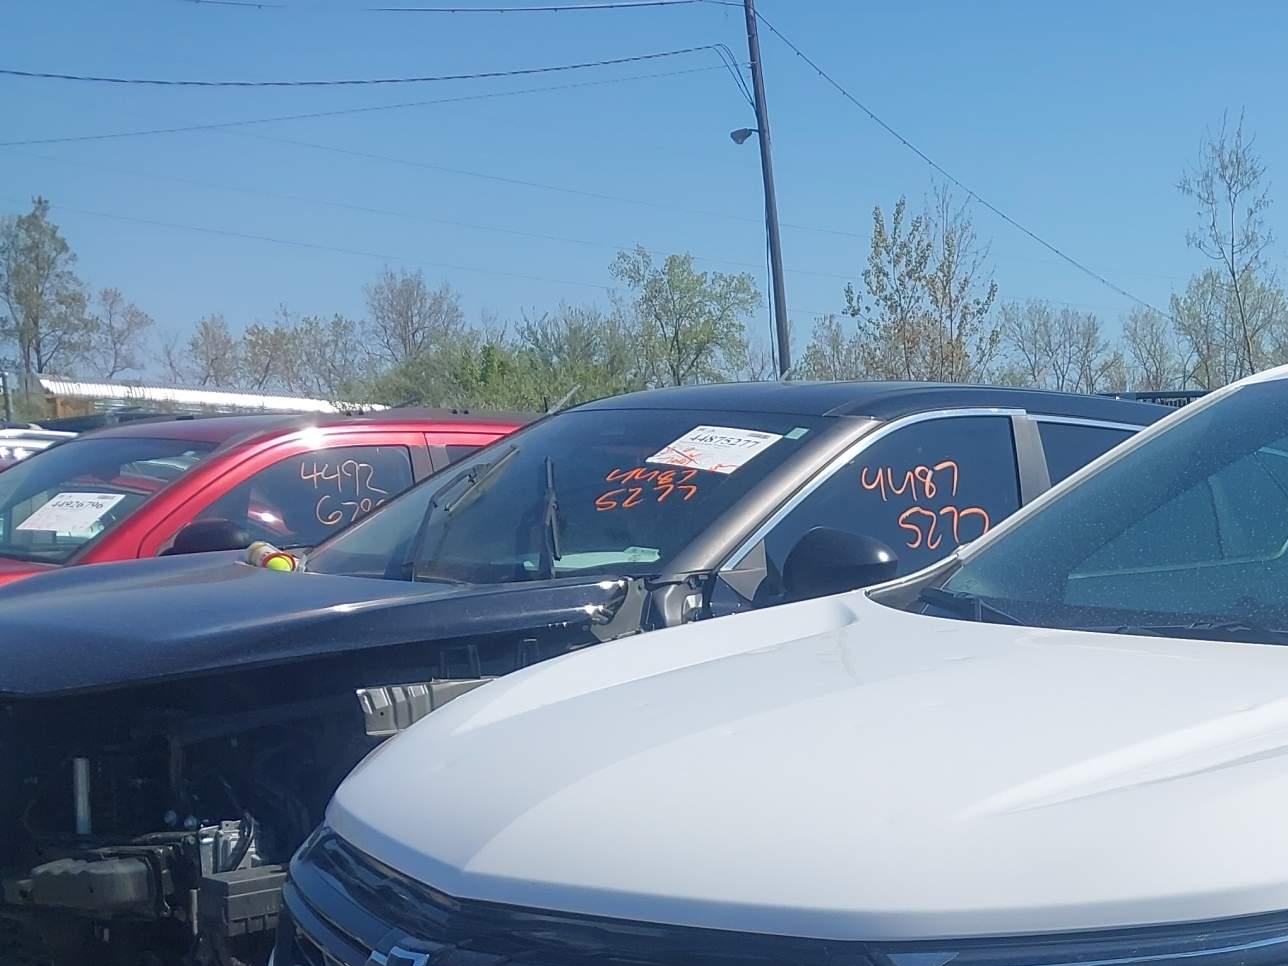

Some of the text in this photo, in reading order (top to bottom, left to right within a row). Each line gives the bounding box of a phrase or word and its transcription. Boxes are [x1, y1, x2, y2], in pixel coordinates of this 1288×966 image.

[690, 433, 760, 448] 44875277
[301, 460, 388, 496] 4492
[862, 460, 958, 501] 4487
[595, 484, 697, 511] 5277
[898, 506, 990, 549] 5277
